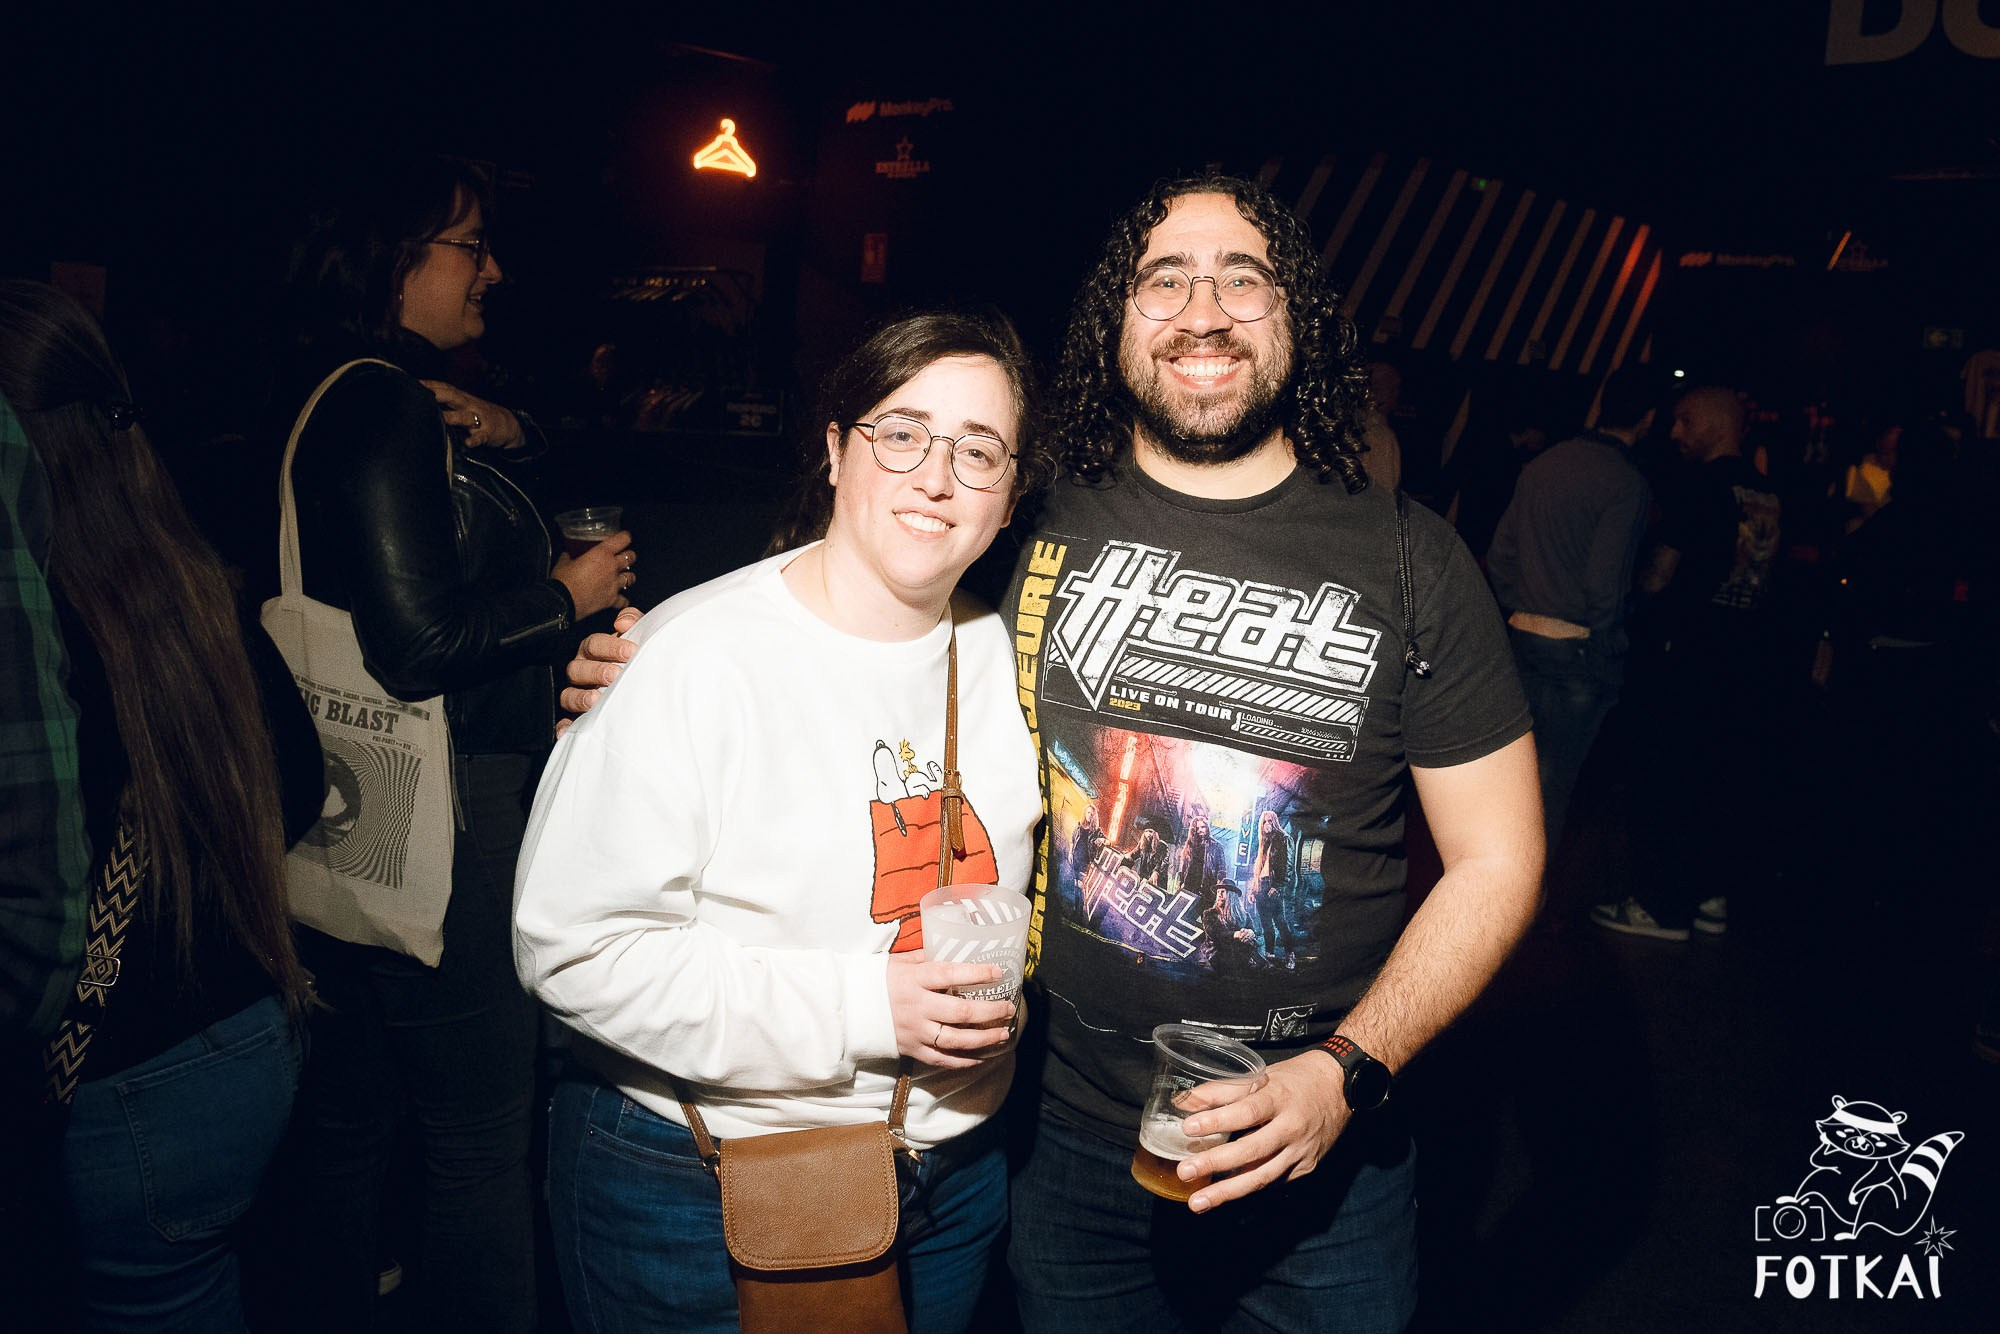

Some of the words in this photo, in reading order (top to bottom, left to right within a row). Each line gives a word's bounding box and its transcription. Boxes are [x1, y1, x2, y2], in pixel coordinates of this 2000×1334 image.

[325, 699, 399, 734] BLAST
[1108, 697, 1141, 711] 2023
[1109, 685, 1150, 703] LIVE
[1154, 694, 1179, 709] ON
[1185, 700, 1232, 720] TOUR
